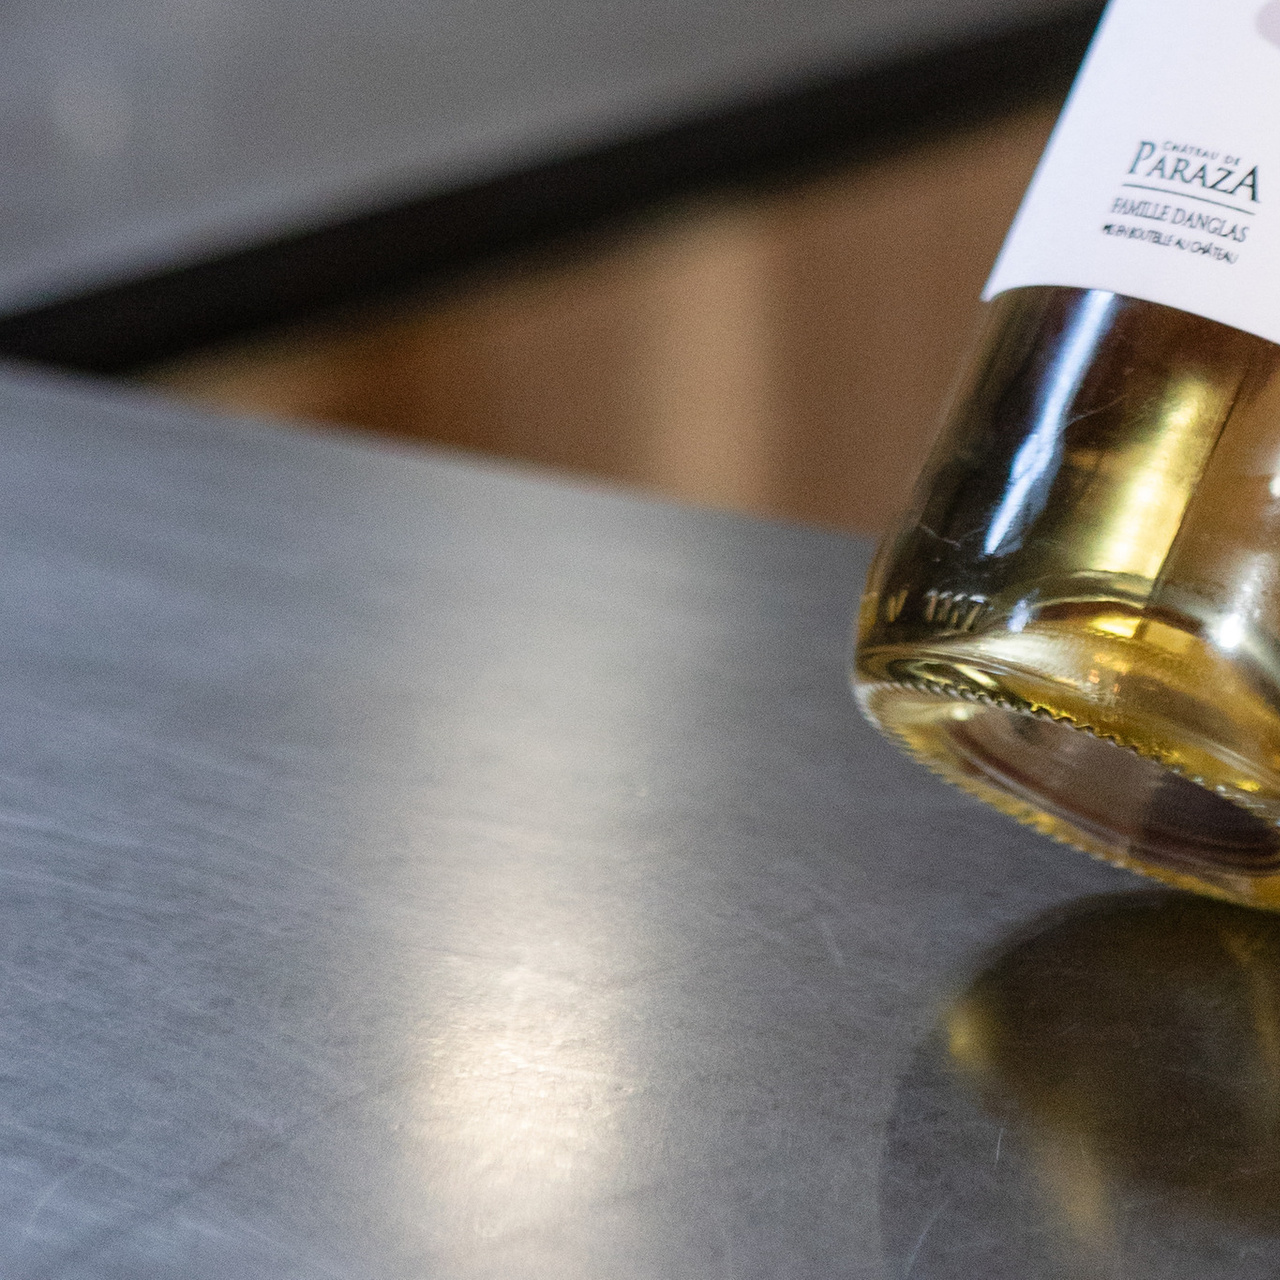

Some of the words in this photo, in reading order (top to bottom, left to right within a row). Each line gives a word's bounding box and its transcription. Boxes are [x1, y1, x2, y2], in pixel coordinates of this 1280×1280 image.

[1127, 139, 1261, 204] PARAZA
[1224, 154, 1242, 166] DE
[1110, 196, 1171, 222] FAMILLE
[1170, 206, 1251, 244] DANGLAS
